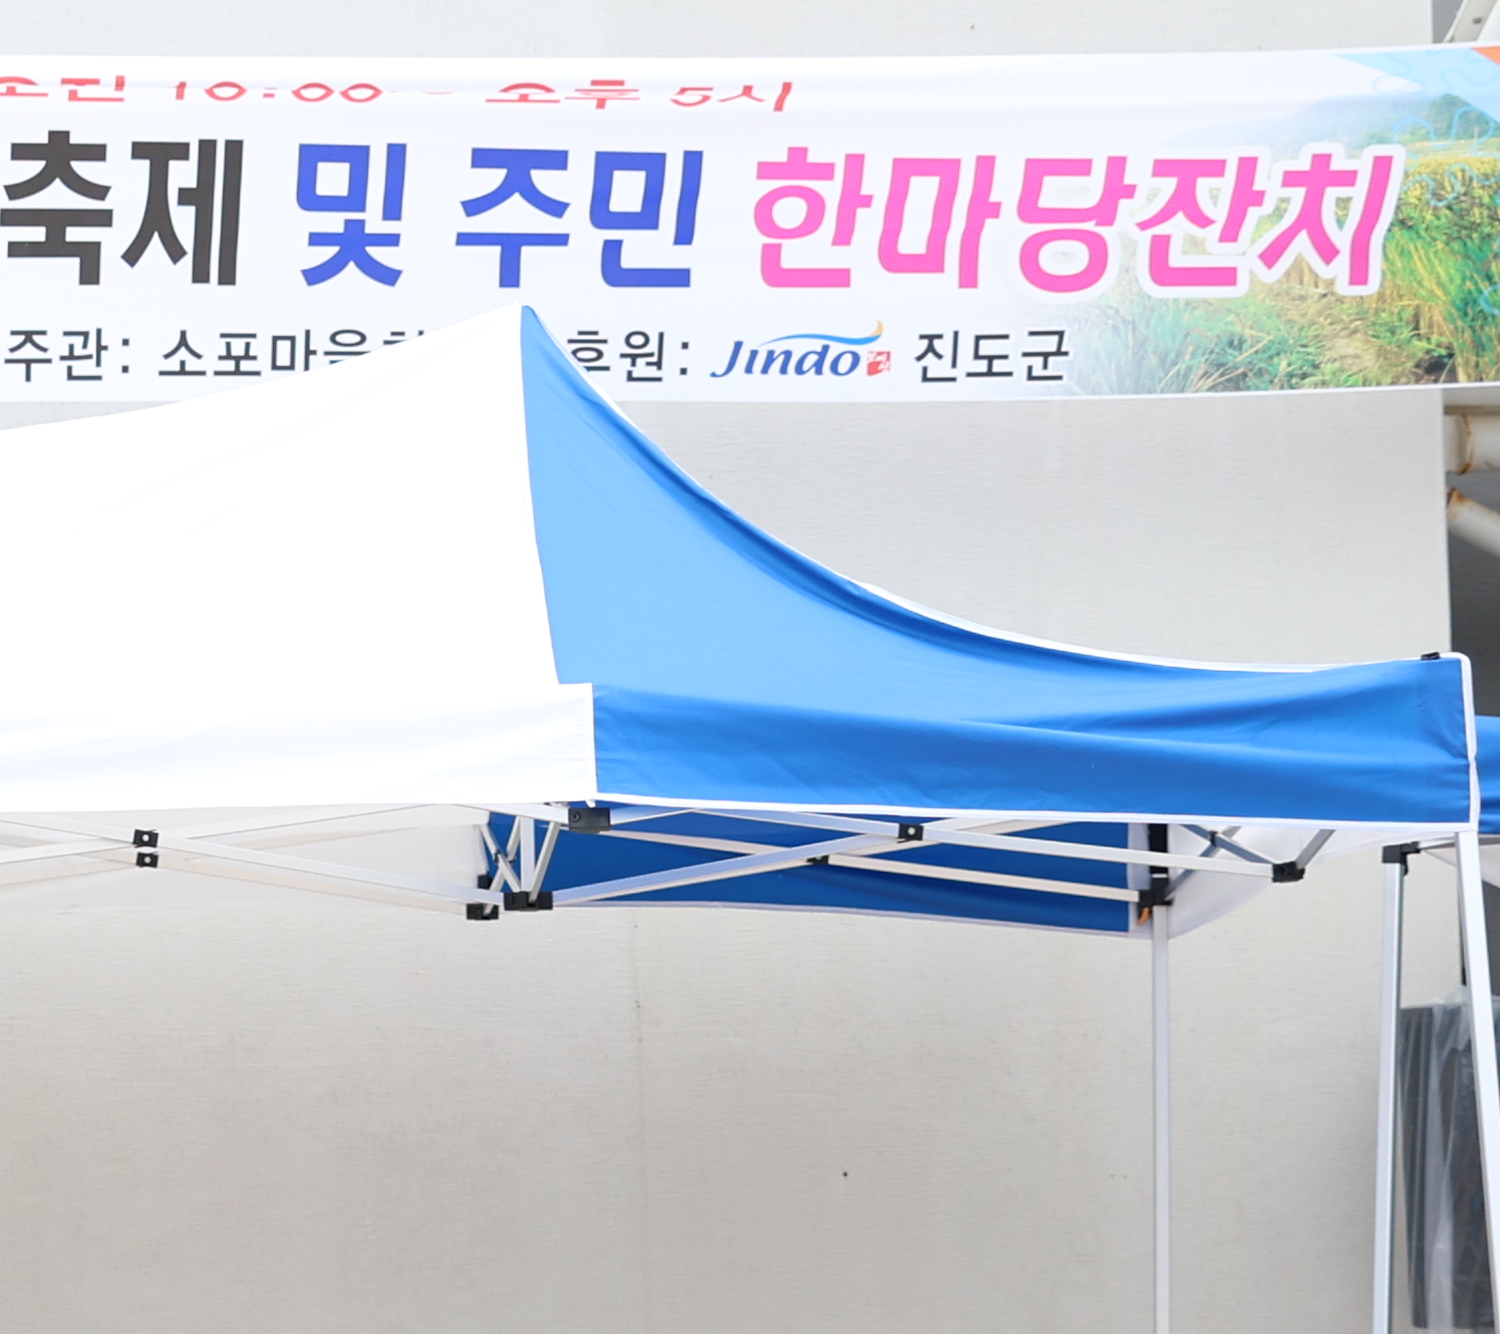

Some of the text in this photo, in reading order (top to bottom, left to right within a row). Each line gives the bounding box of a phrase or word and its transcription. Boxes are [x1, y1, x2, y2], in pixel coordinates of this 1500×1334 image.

[296, 142, 407, 288] 및
[454, 146, 704, 289] 주민
[753, 146, 1394, 294] 한마당잔치
[4, 328, 131, 383] 주관:
[710, 339, 862, 378] Jindo
[914, 330, 1070, 383] 진도군
